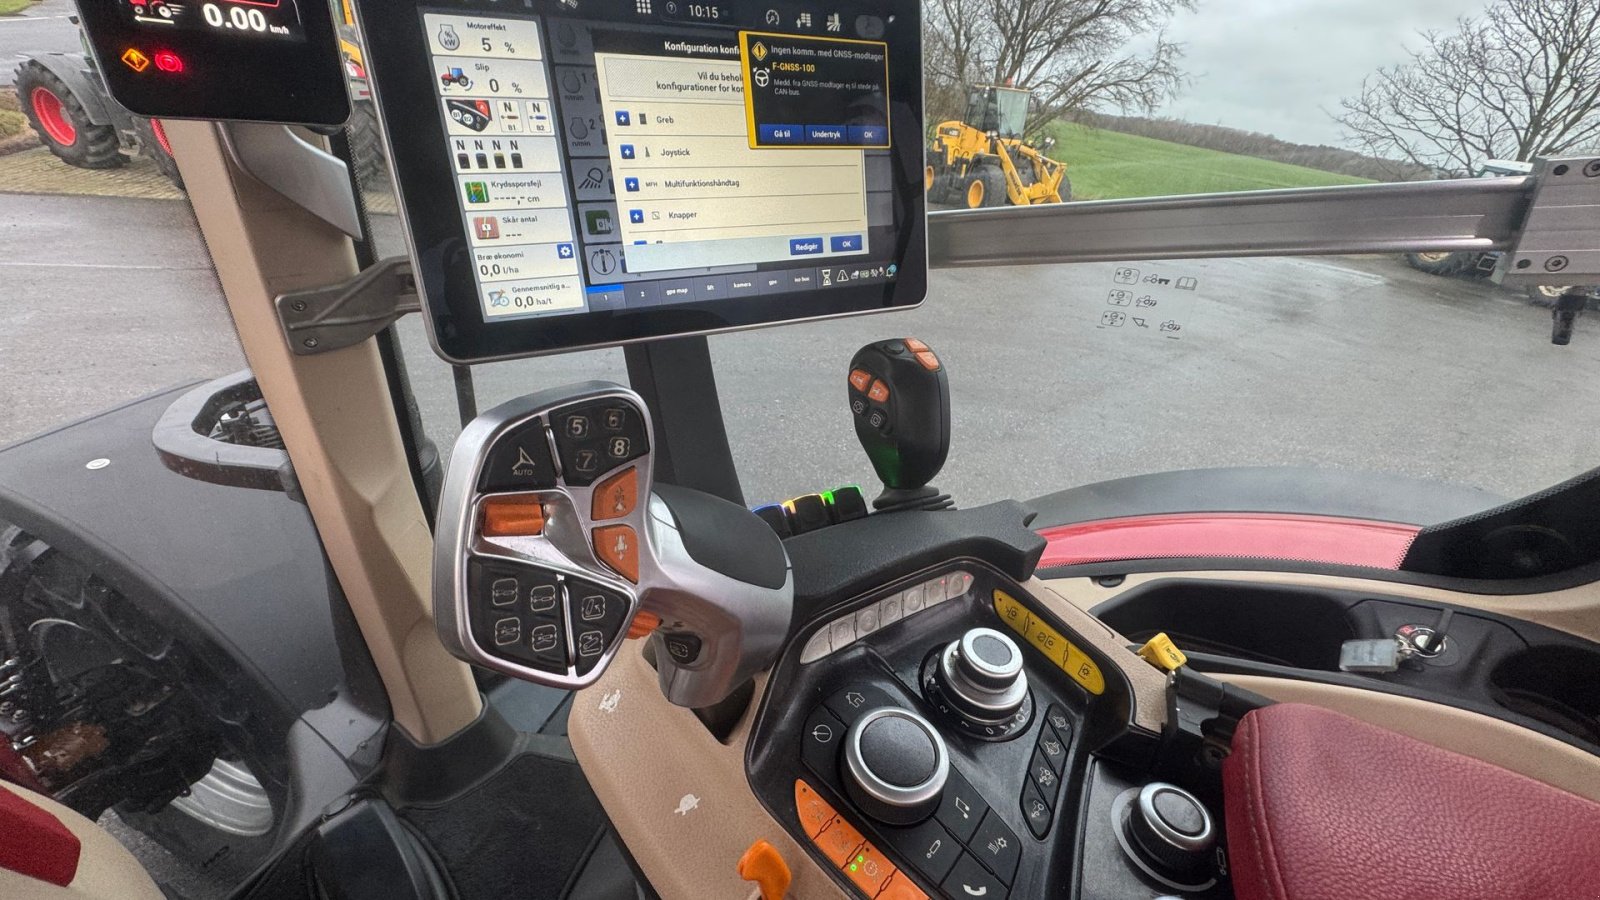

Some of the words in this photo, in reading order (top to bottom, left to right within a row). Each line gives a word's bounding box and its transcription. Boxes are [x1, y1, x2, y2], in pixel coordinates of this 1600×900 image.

[688, 4, 718, 18] 10:15
[203, 3, 266, 32] 0.00
[270, 24, 290, 35] km/h
[467, 22, 506, 32] Motoreffekt
[481, 38, 492, 52] 5
[504, 41, 515, 53] %
[664, 41, 718, 53] Konfiguration
[771, 45, 791, 57] Ingen
[792, 47, 816, 56] komm.
[818, 49, 832, 58] med
[833, 50, 884, 61] GNSS-modtager
[475, 63, 490, 72] Slip
[772, 62, 815, 73] F-GNSS-100
[697, 72, 708, 80] Vil
[709, 73, 720, 81] du
[721, 73, 744, 81] behol
[489, 78, 499, 92] 0
[512, 82, 522, 93] %
[656, 81, 717, 92] konfigurationer
[719, 84, 729, 92] for
[504, 102, 512, 112] N
[532, 103, 540, 113] N
[589, 119, 595, 129] 2
[656, 115, 674, 124] Greb
[774, 129, 783, 137] Gå
[812, 130, 841, 139] Undertryk
[456, 140, 465, 150] N
[475, 140, 483, 150] N
[493, 140, 501, 150] N
[510, 140, 518, 150] N
[660, 148, 690, 157] Joystick
[491, 180, 542, 189] Krydssporsfejl
[665, 178, 740, 188] Multifunktionshåndtag
[527, 195, 540, 203] cm
[520, 215, 538, 223] antal
[668, 210, 697, 220] Knapper
[494, 252, 524, 260] økonomi
[480, 264, 500, 277] 0,0
[503, 266, 519, 274] l/ha
[512, 284, 560, 293] Gennemsnitlig
[514, 296, 534, 309] 0,0
[536, 298, 552, 306] ha/t
[608, 412, 619, 427] 6
[572, 420, 583, 435] 5
[614, 439, 625, 456] 8
[582, 453, 592, 468] 7
[940, 705, 949, 714] 2
